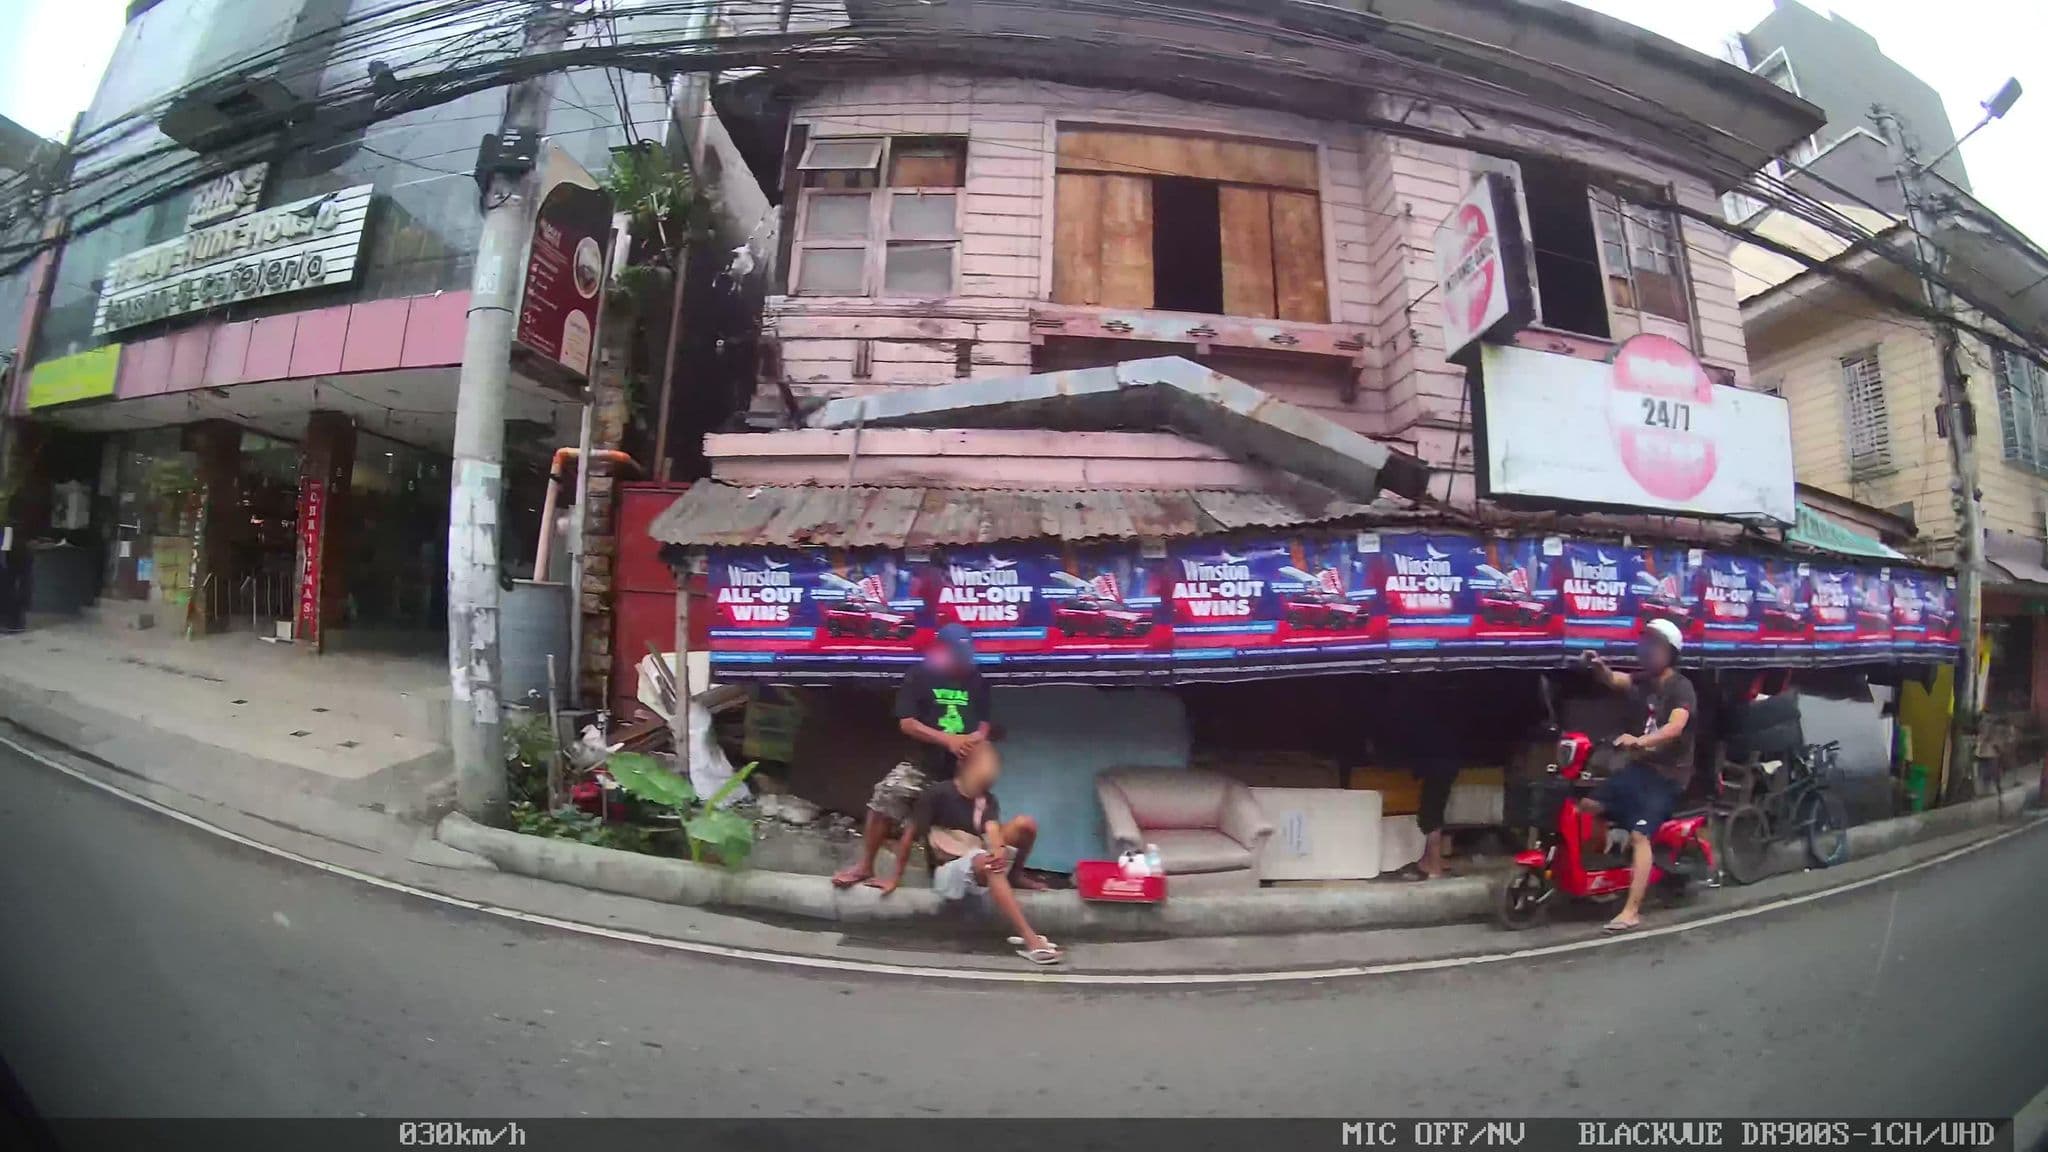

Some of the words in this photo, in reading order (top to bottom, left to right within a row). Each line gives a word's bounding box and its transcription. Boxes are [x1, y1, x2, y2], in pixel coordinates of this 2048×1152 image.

[1642, 397, 1689, 431] 24/7
[1182, 559, 1250, 581] Winston
[1393, 553, 1451, 575] Winston
[728, 564, 790, 586] Winston
[949, 565, 1018, 586] Winston
[1172, 581, 1264, 598] ALL-OUT
[1385, 576, 1463, 592] ALL-OUT
[1563, 579, 1627, 596] ALL-OUT
[717, 587, 804, 603] ALL-OUT
[939, 586, 1033, 603] ALL-OUT
[1573, 595, 1617, 611] WINS
[731, 605, 790, 621] WINS
[954, 604, 1019, 621] WINS
[1188, 599, 1250, 616] WINS
